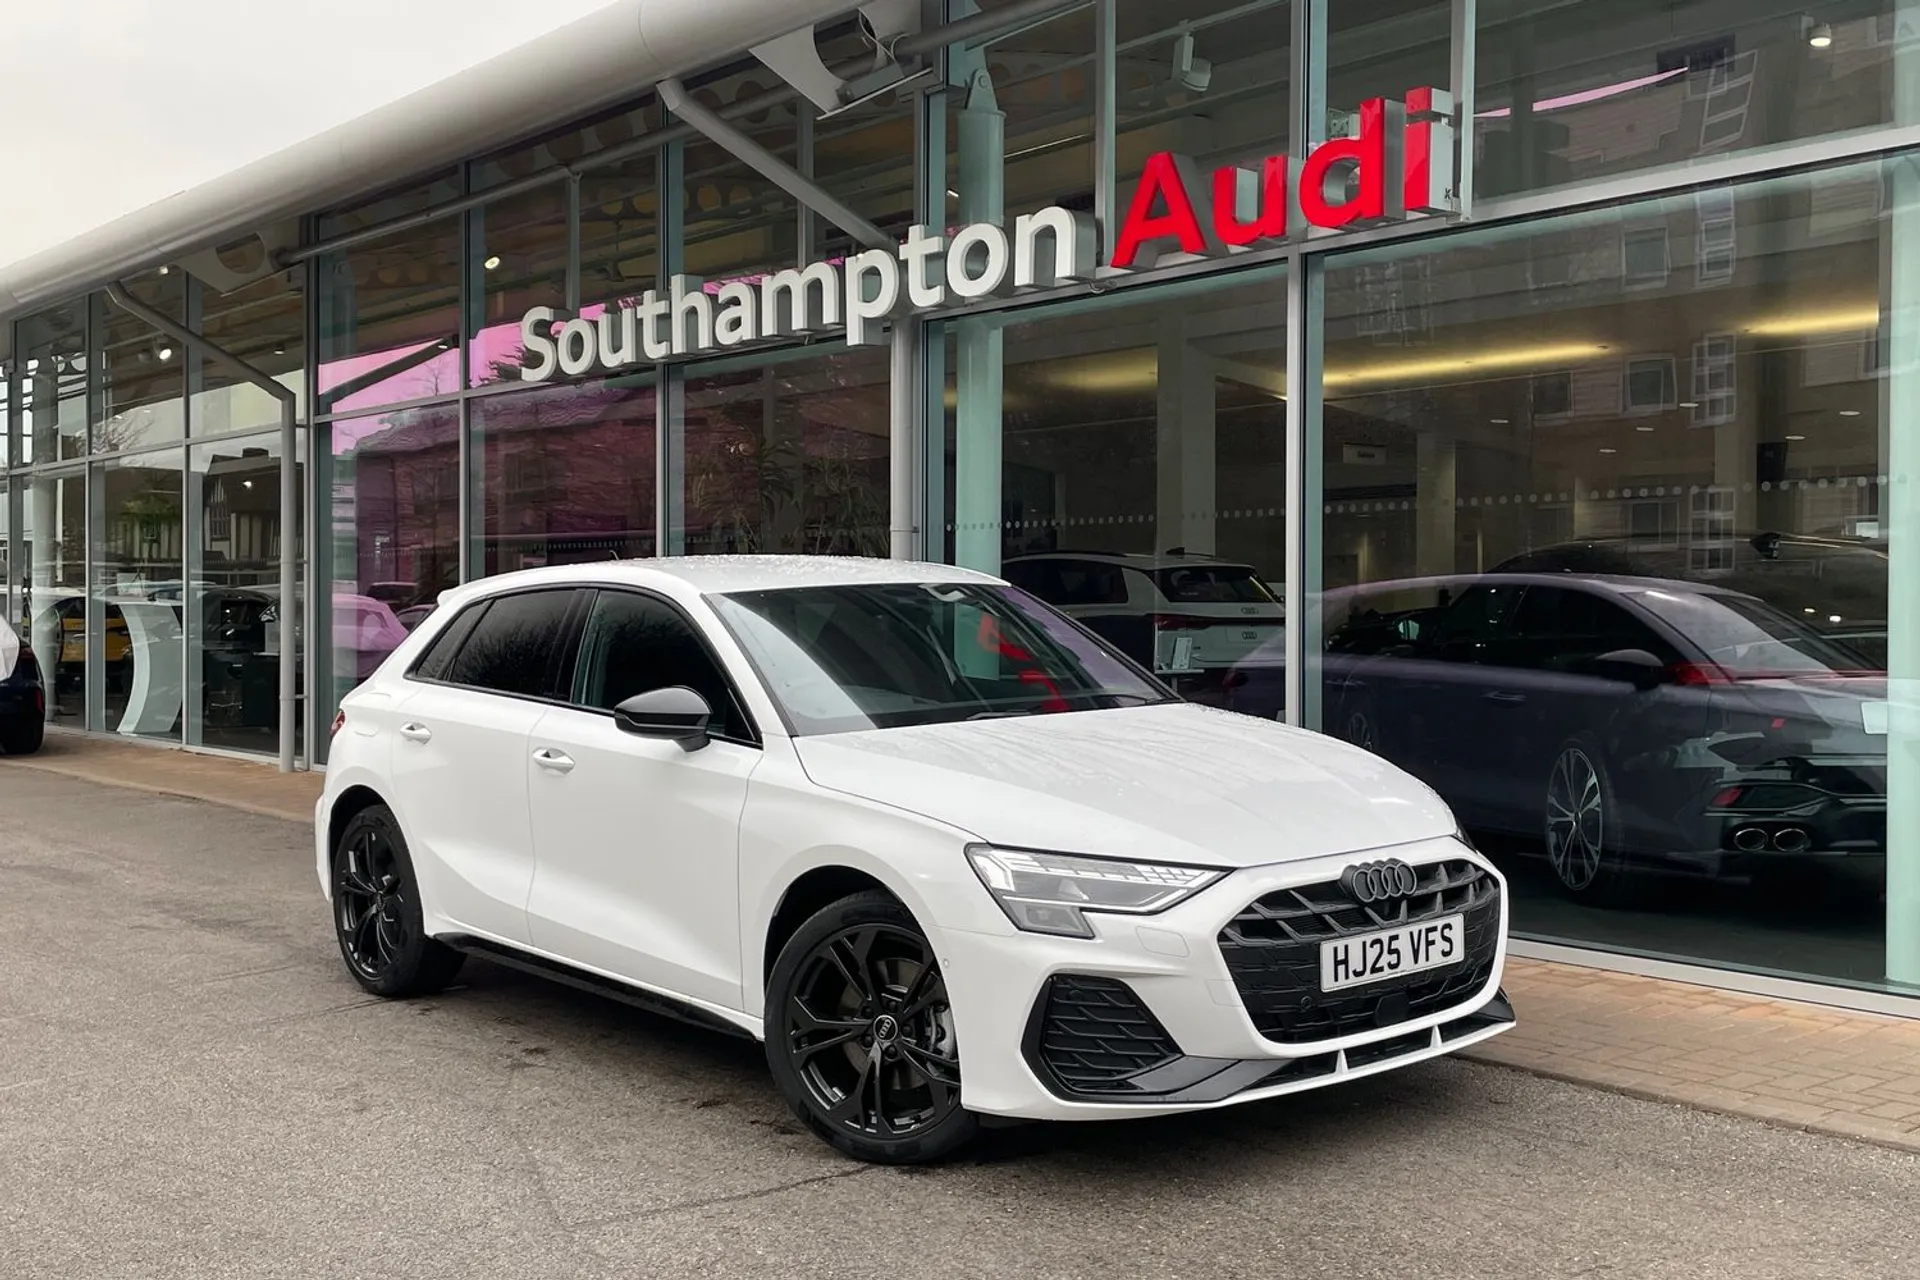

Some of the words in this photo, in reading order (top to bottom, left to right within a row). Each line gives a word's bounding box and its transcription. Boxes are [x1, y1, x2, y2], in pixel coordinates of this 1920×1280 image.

[520, 205, 1077, 382] Southampton
[1110, 86, 1430, 268] Audi
[1333, 935, 1400, 982] HJ25
[1410, 923, 1453, 964] VFS
